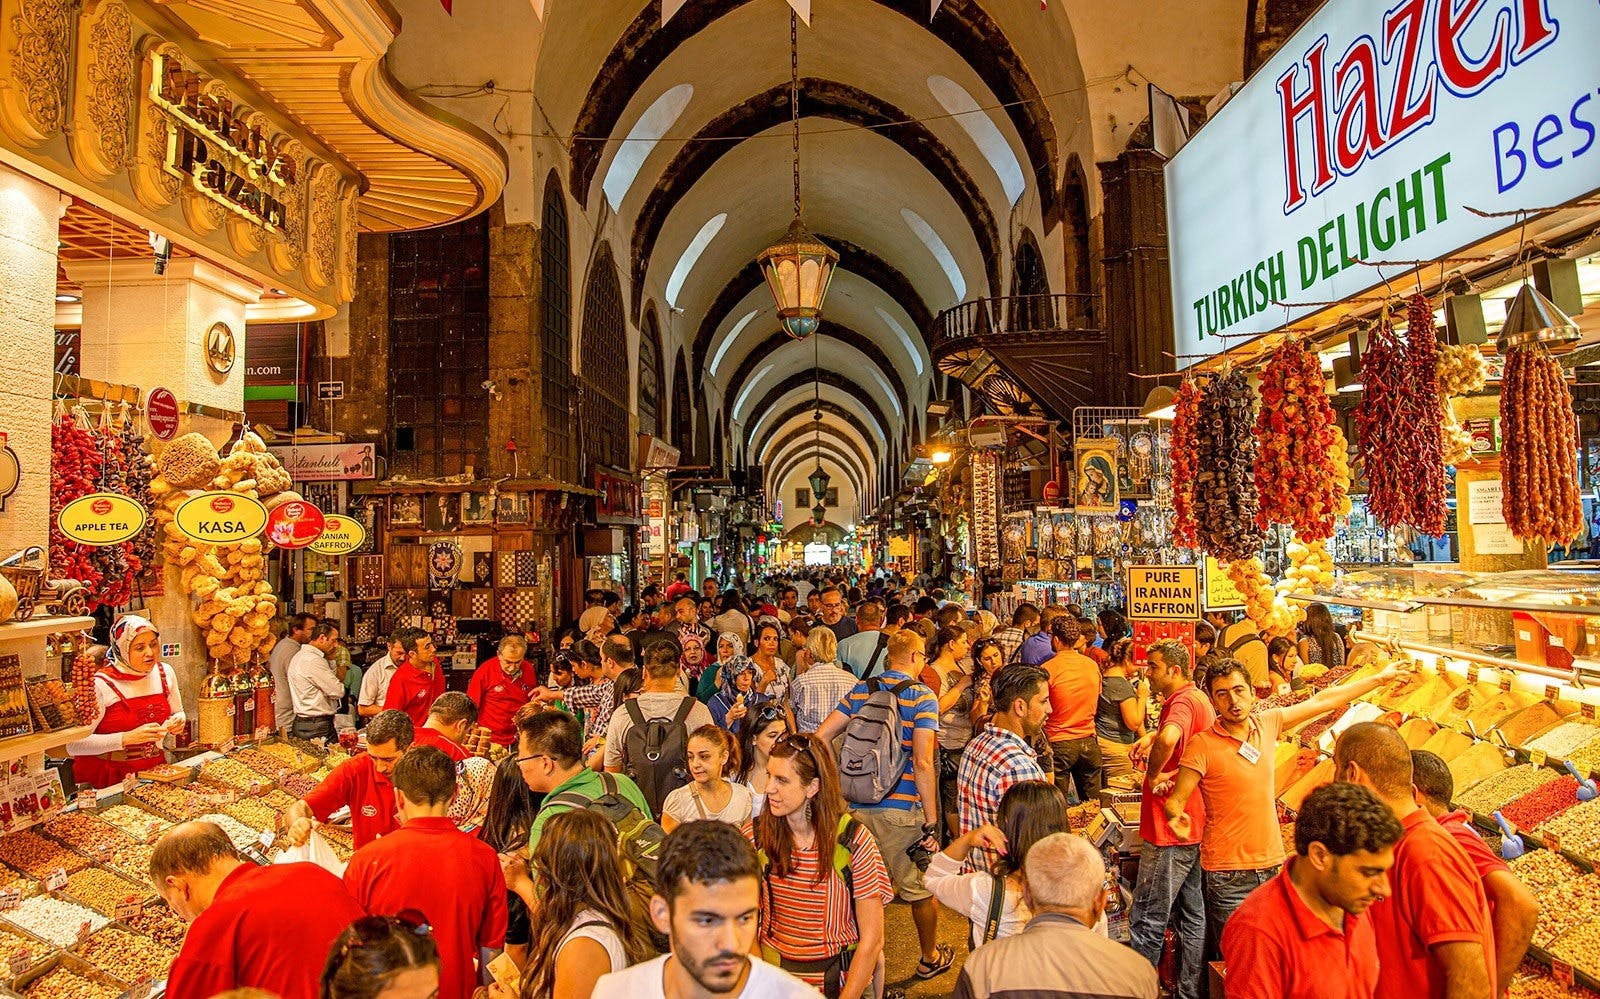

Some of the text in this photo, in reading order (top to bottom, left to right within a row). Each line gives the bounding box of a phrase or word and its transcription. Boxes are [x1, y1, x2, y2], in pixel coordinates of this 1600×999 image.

[1492, 88, 1600, 195] Bes
[1193, 151, 1452, 342] TURKISH DELIGHT
[75, 522, 129, 532] APPLE TEA
[198, 521, 246, 534] KASA
[314, 541, 352, 549] SAFFRON
[1145, 572, 1180, 583] PURE
[1135, 587, 1192, 599] IRANIAN
[1134, 602, 1195, 614] SAFFRON
